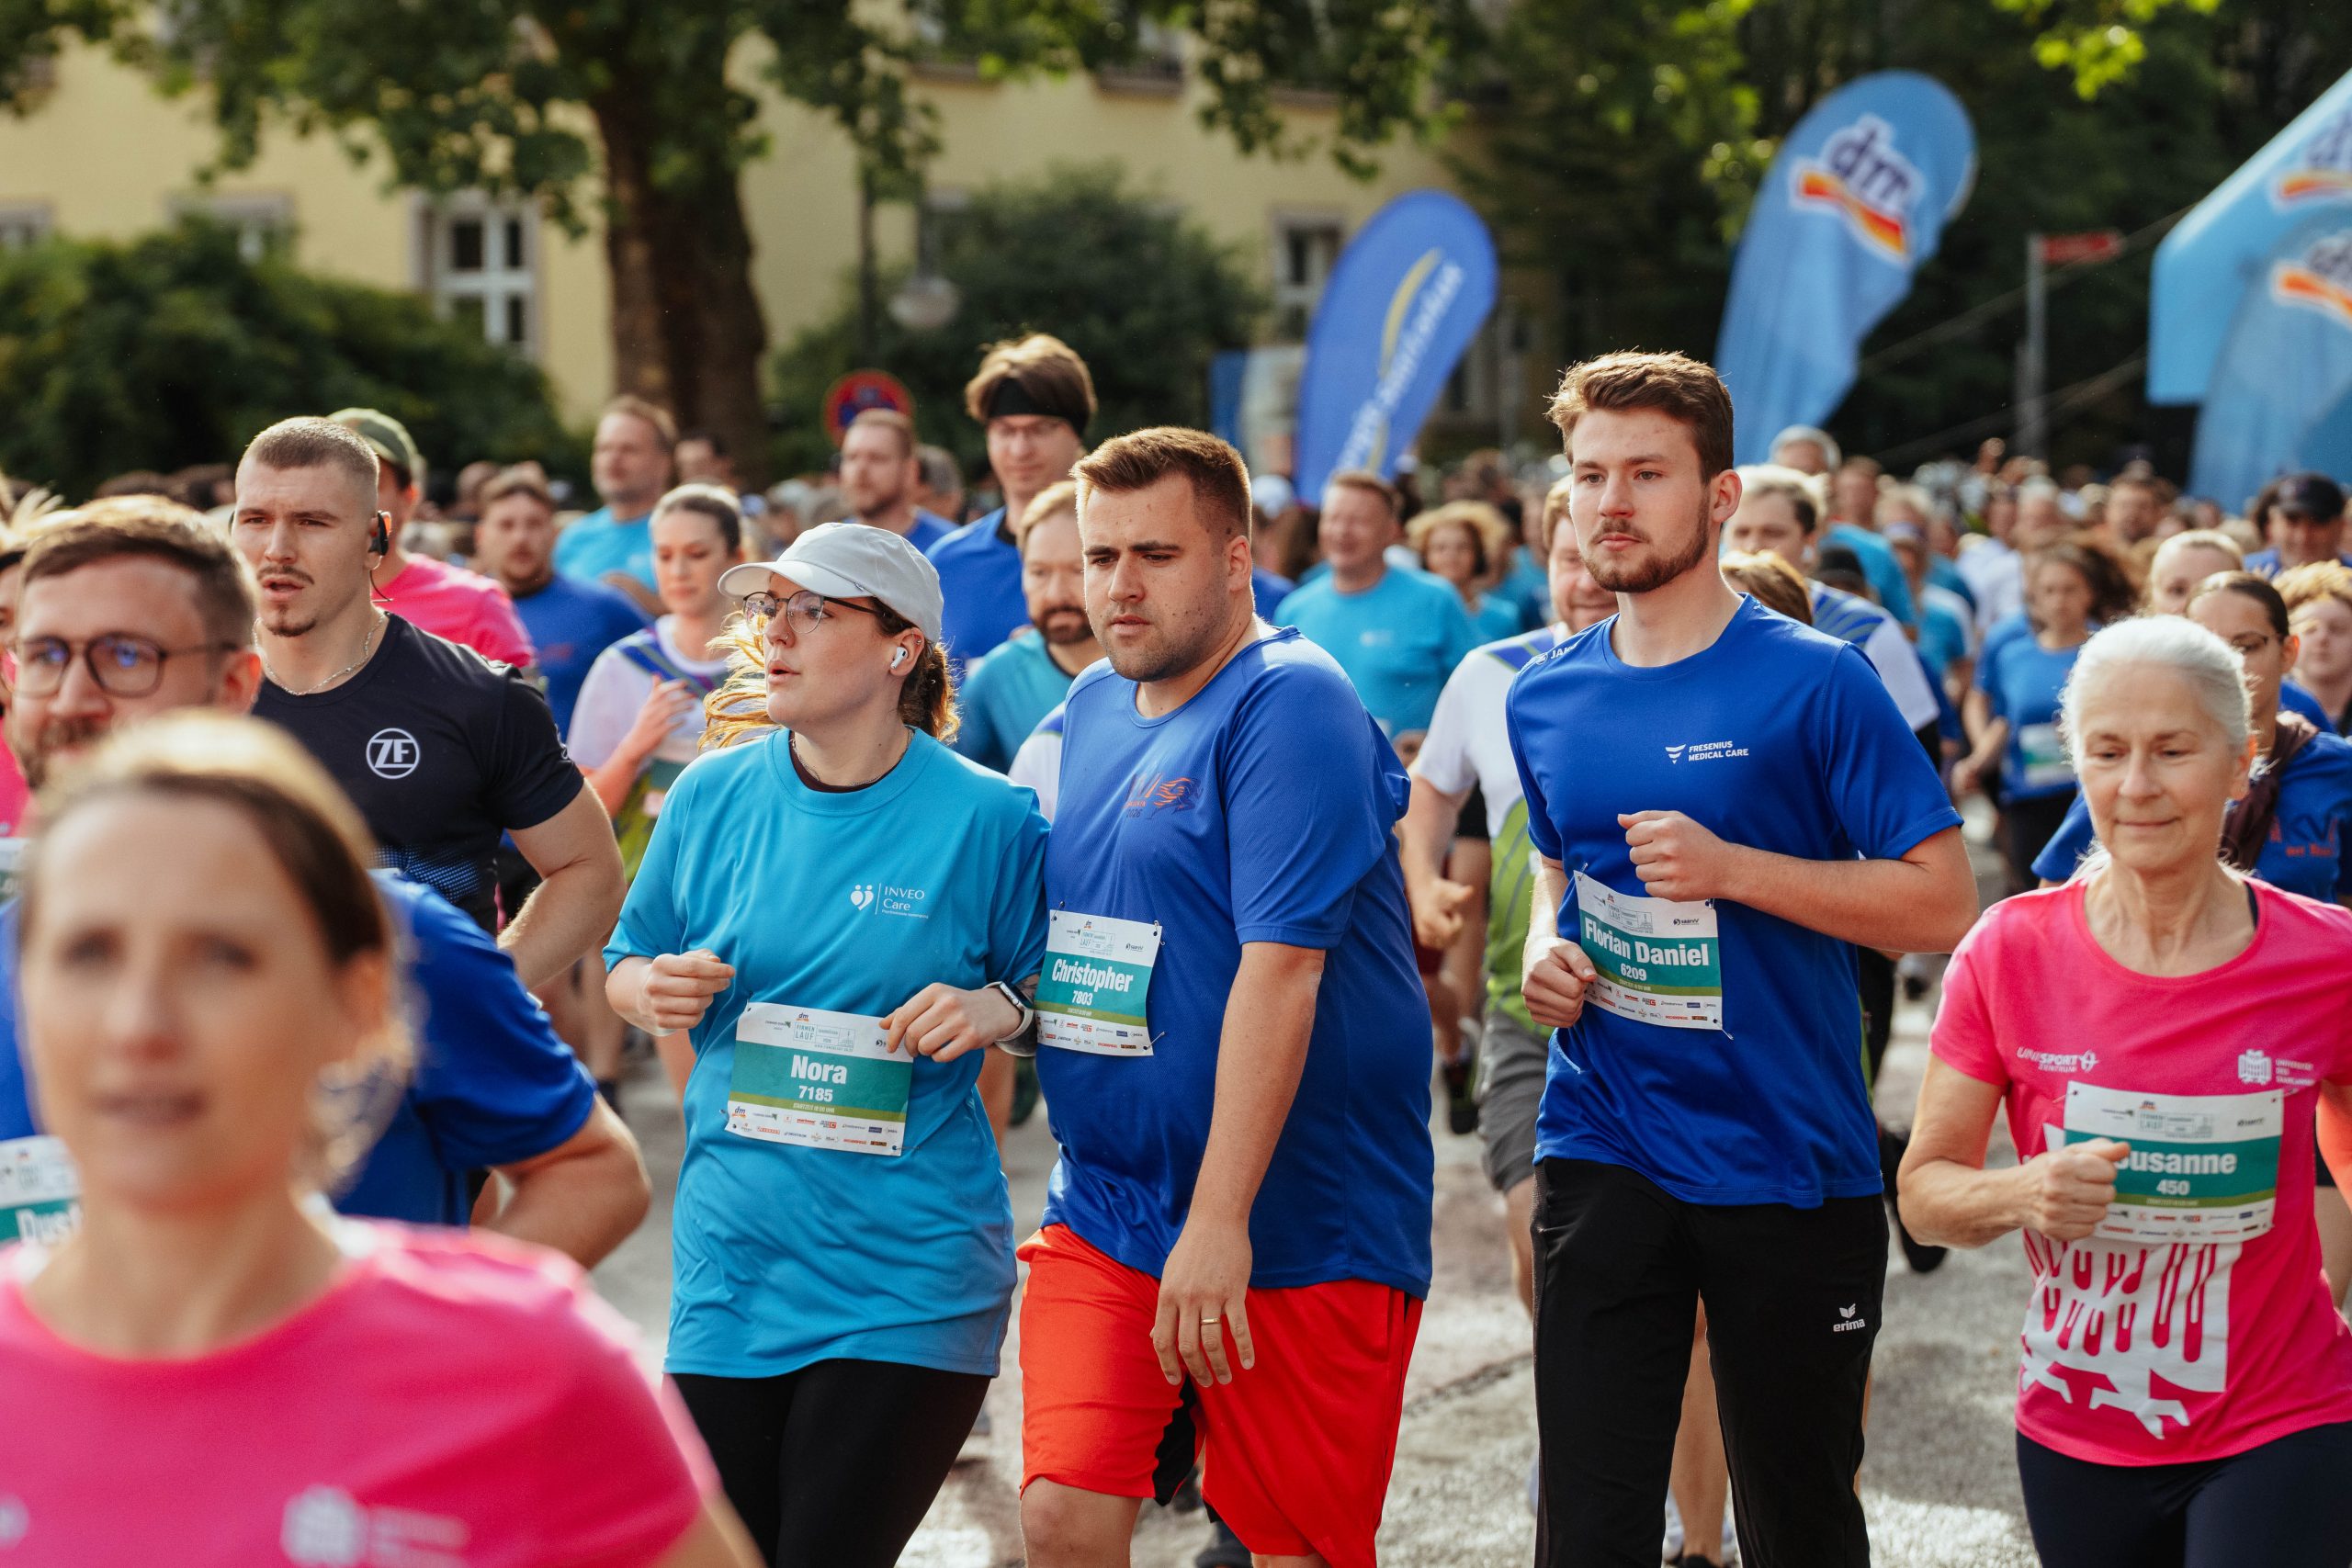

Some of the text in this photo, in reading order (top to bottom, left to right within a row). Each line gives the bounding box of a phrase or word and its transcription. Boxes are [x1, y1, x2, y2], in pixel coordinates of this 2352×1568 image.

[1551, 644, 1577, 660] JA
[368, 735, 417, 772] ZF
[1689, 740, 1733, 752] FRESENIUS
[1689, 749, 1748, 761] MEDICAL CARE
[884, 886, 925, 900] INVEO
[883, 898, 910, 910] Care
[1585, 918, 1631, 959] Florian
[1634, 941, 1709, 965] Daniel
[1052, 959, 1134, 992] Christopher
[1621, 963, 1646, 981] 6209
[1071, 990, 1093, 1006] 7803
[791, 1055, 847, 1084] Nora
[798, 1085, 833, 1102] 7185
[2156, 1179, 2190, 1195] 450
[1833, 1318, 1866, 1332] erima
